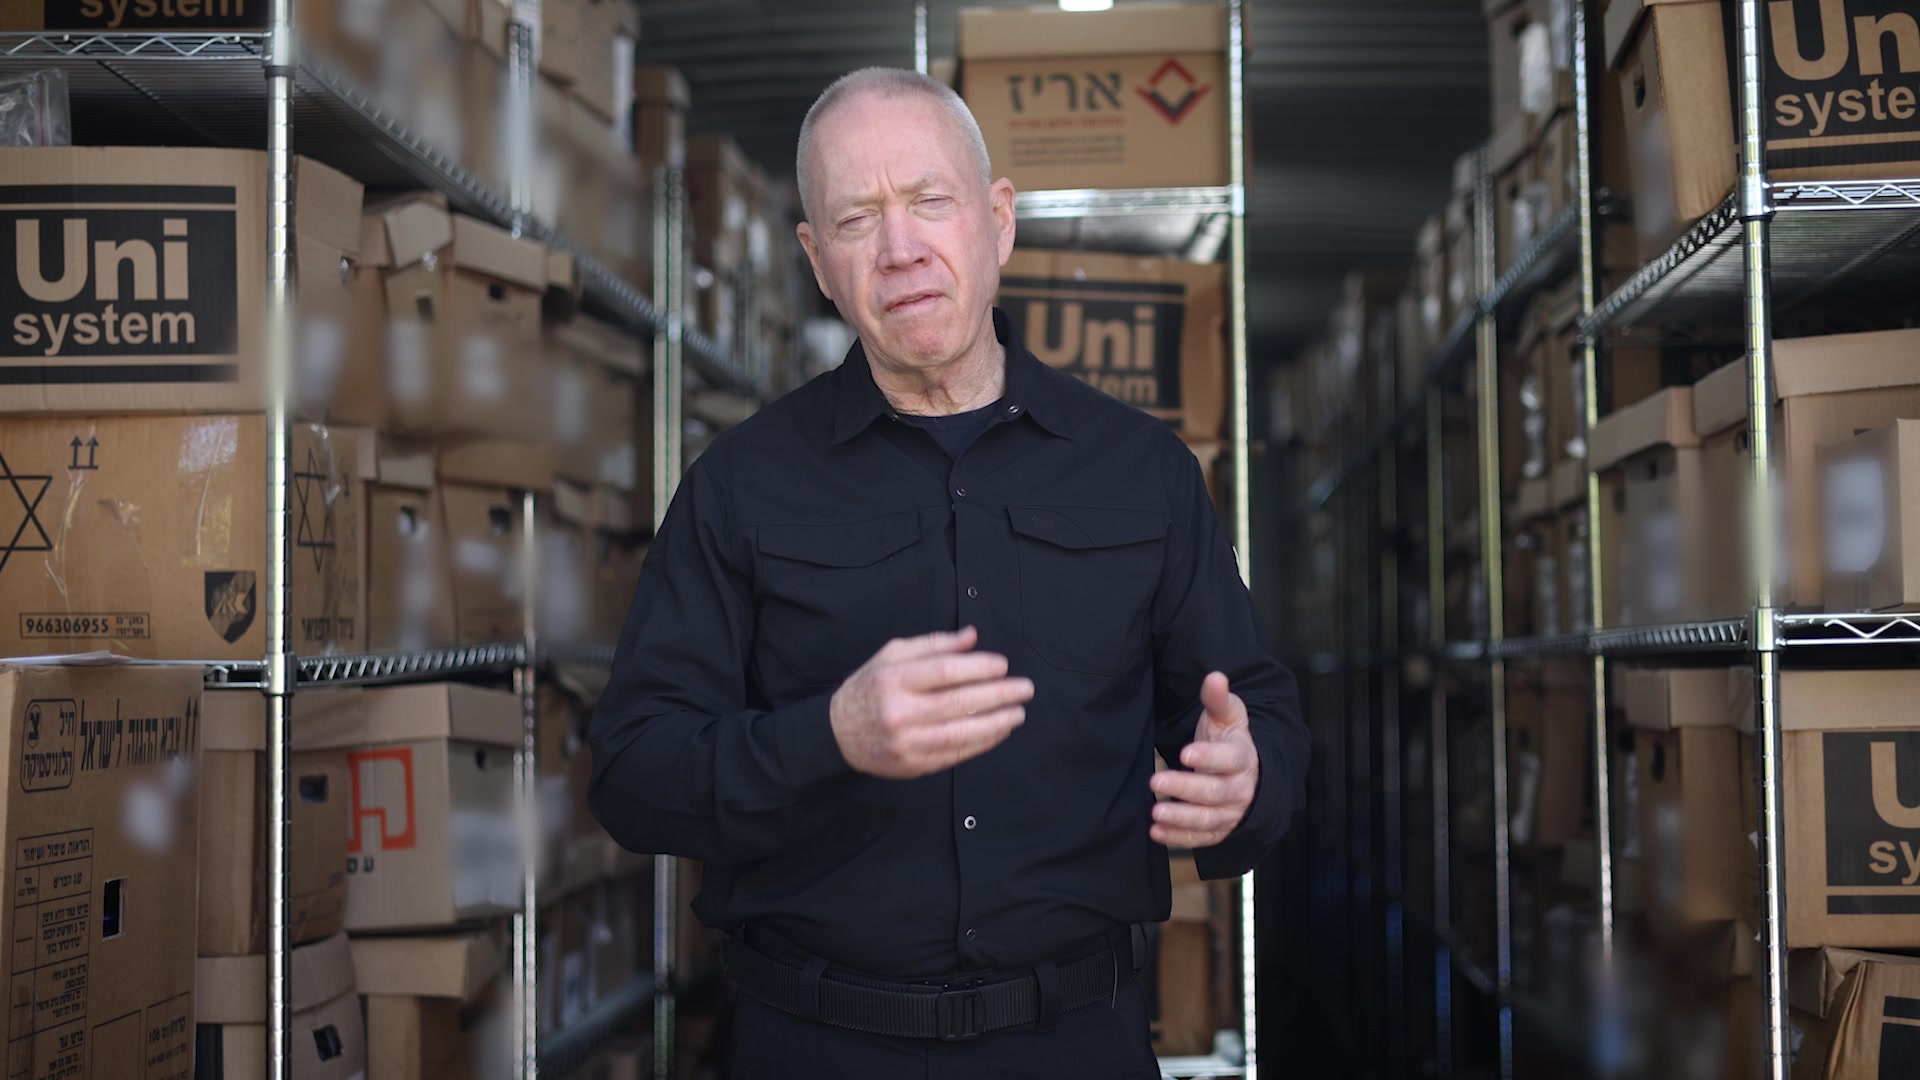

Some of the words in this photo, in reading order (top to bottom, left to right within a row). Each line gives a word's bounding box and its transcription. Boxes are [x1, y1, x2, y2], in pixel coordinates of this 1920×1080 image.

[1006, 72, 1125, 114] אריז
[15, 218, 189, 302] Uni
[13, 303, 196, 356] system
[1026, 302, 1156, 370] Uni
[26, 618, 109, 634] 966306955
[59, 707, 75, 736] חיל
[80, 698, 123, 771] לישראל
